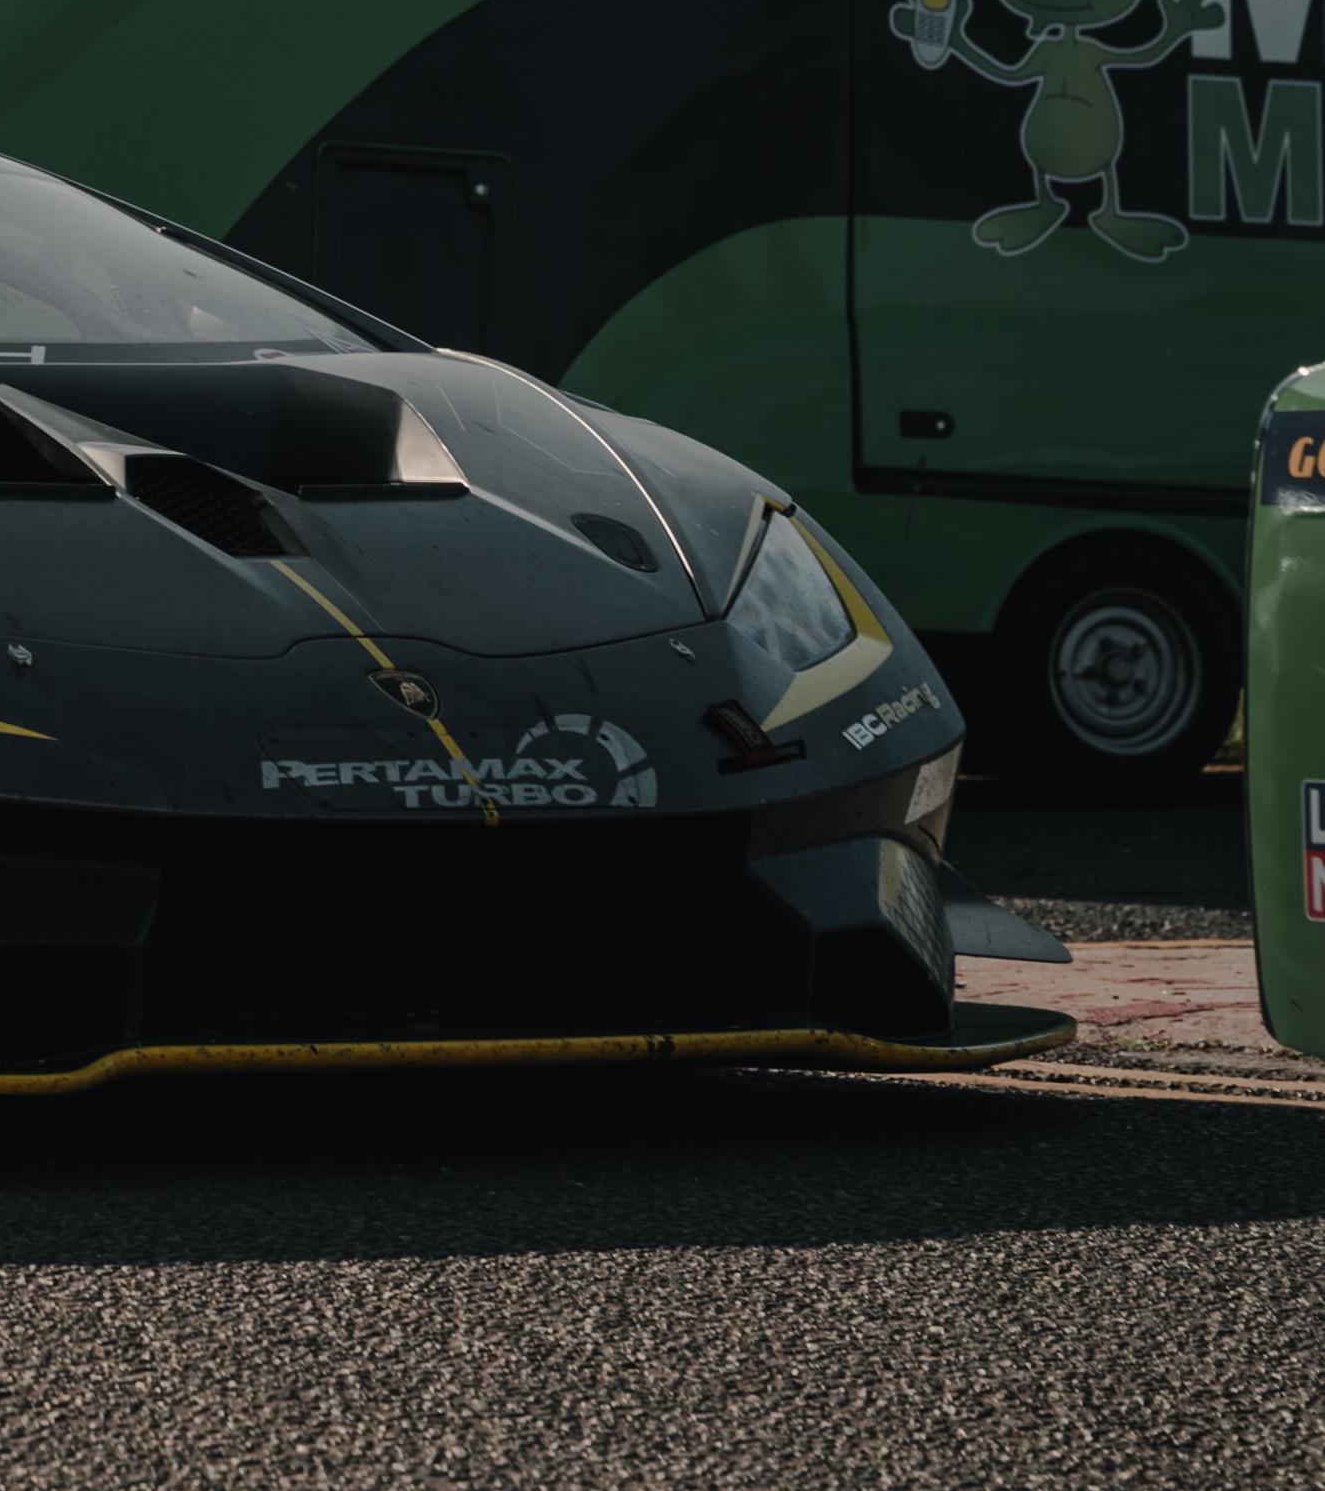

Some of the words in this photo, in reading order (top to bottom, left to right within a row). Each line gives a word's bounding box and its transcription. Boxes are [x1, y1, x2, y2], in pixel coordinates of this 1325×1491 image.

[1187, 74, 1324, 227] M
[842, 712, 887, 750] IBC
[260, 758, 588, 789] PERTAMAX
[393, 783, 599, 808] TURBO
